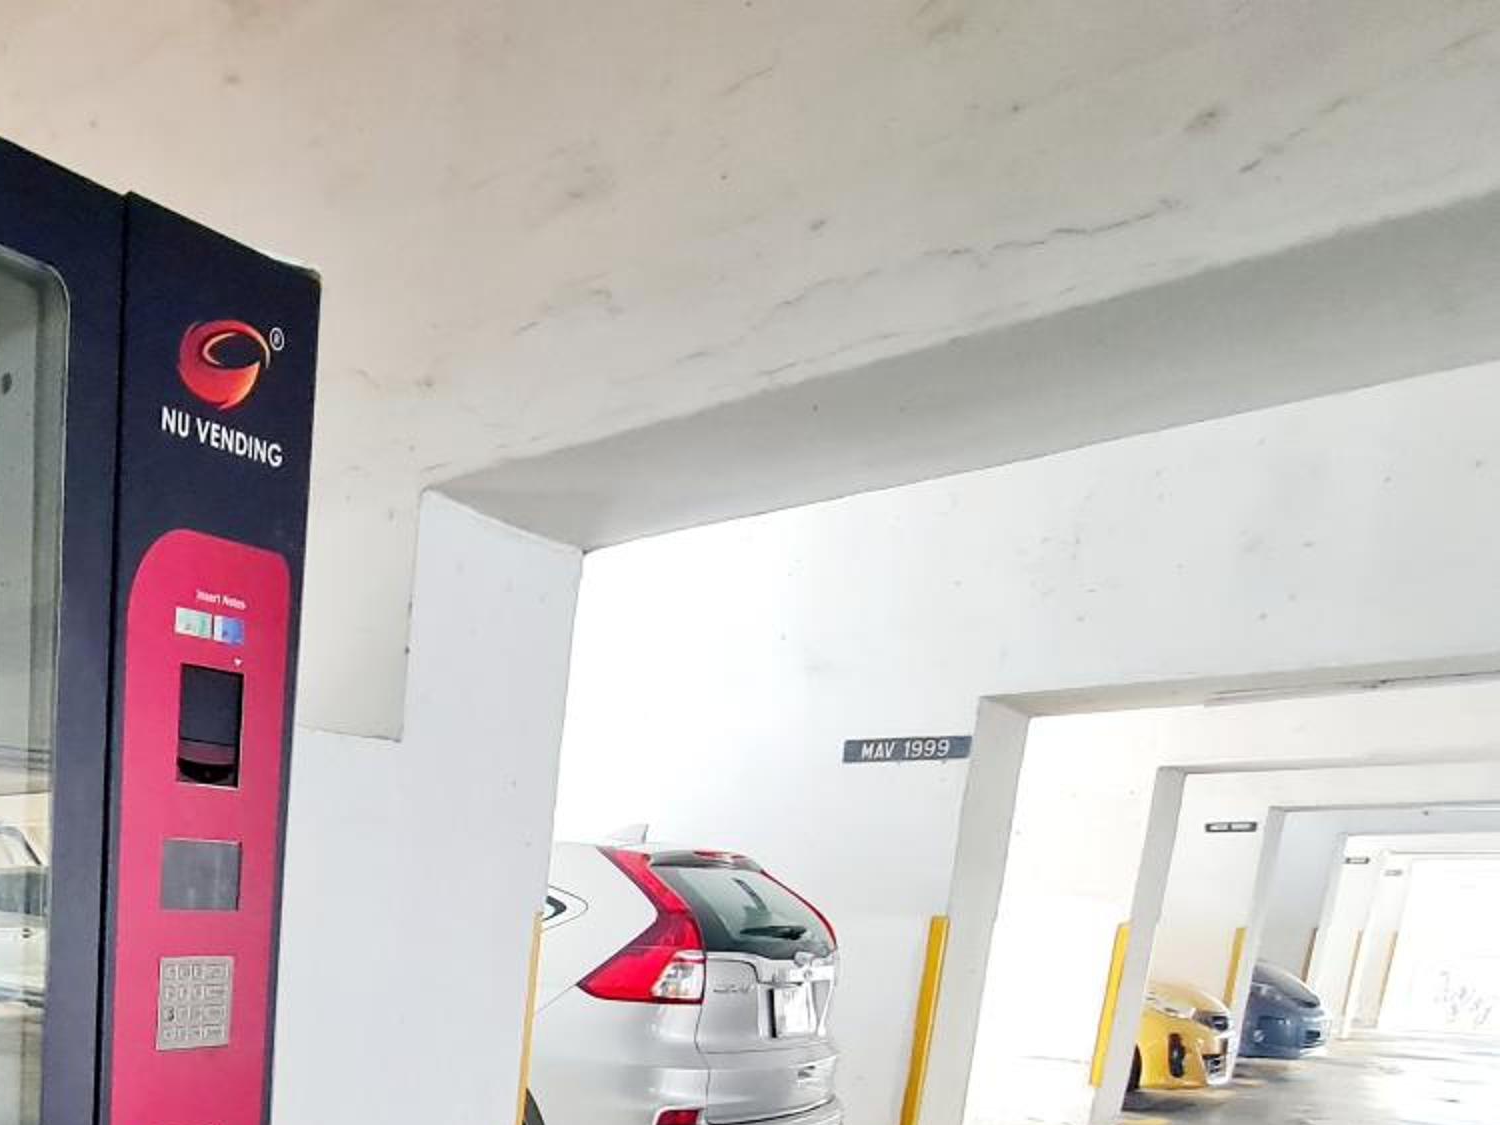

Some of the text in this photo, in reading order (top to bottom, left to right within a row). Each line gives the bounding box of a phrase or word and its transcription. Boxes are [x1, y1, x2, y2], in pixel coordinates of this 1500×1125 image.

[161, 405, 283, 468] NU VENDING
[860, 739, 950, 760] MAV 1999
